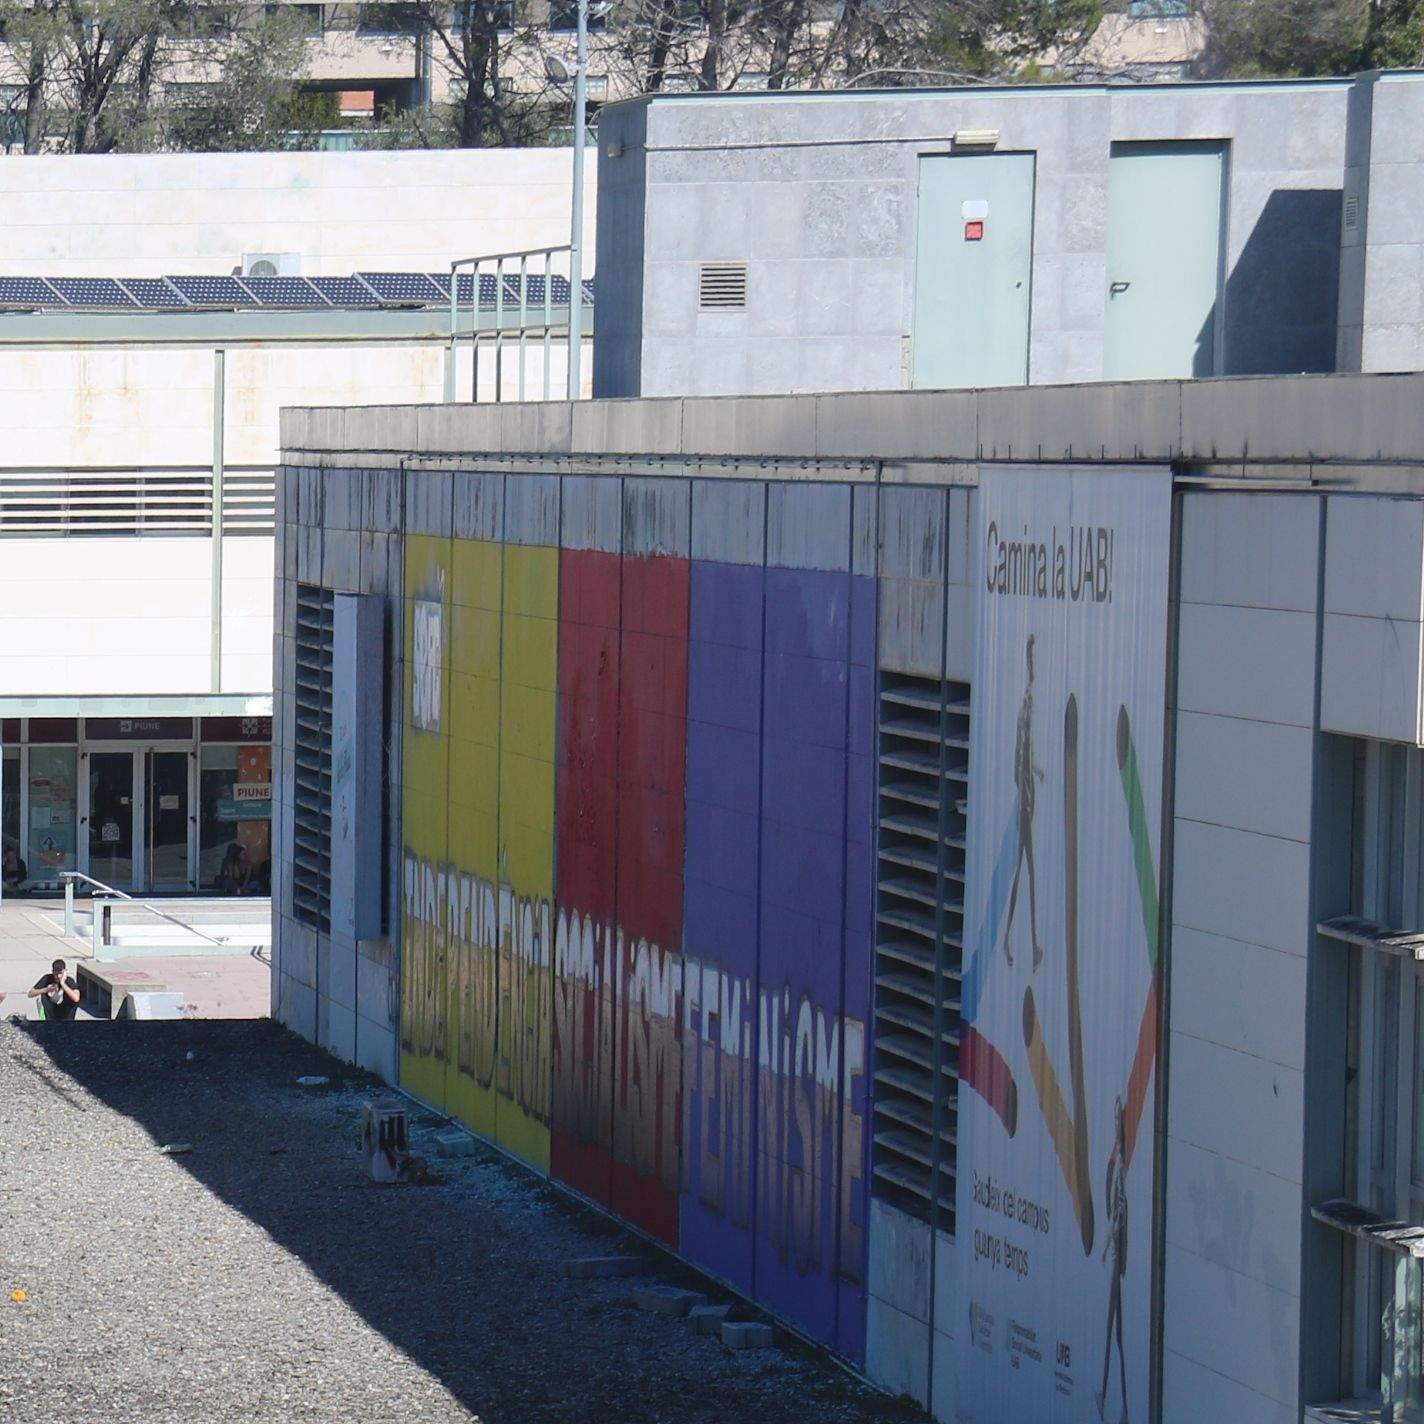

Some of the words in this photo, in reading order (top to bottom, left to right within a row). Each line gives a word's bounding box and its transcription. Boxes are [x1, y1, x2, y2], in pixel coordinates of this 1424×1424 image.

[986, 520, 1048, 599] Camina
[1051, 525, 1066, 600] la
[1069, 526, 1115, 603] UAB!
[237, 787, 271, 798] PIUNE
[1017, 1196, 1050, 1235] campus
